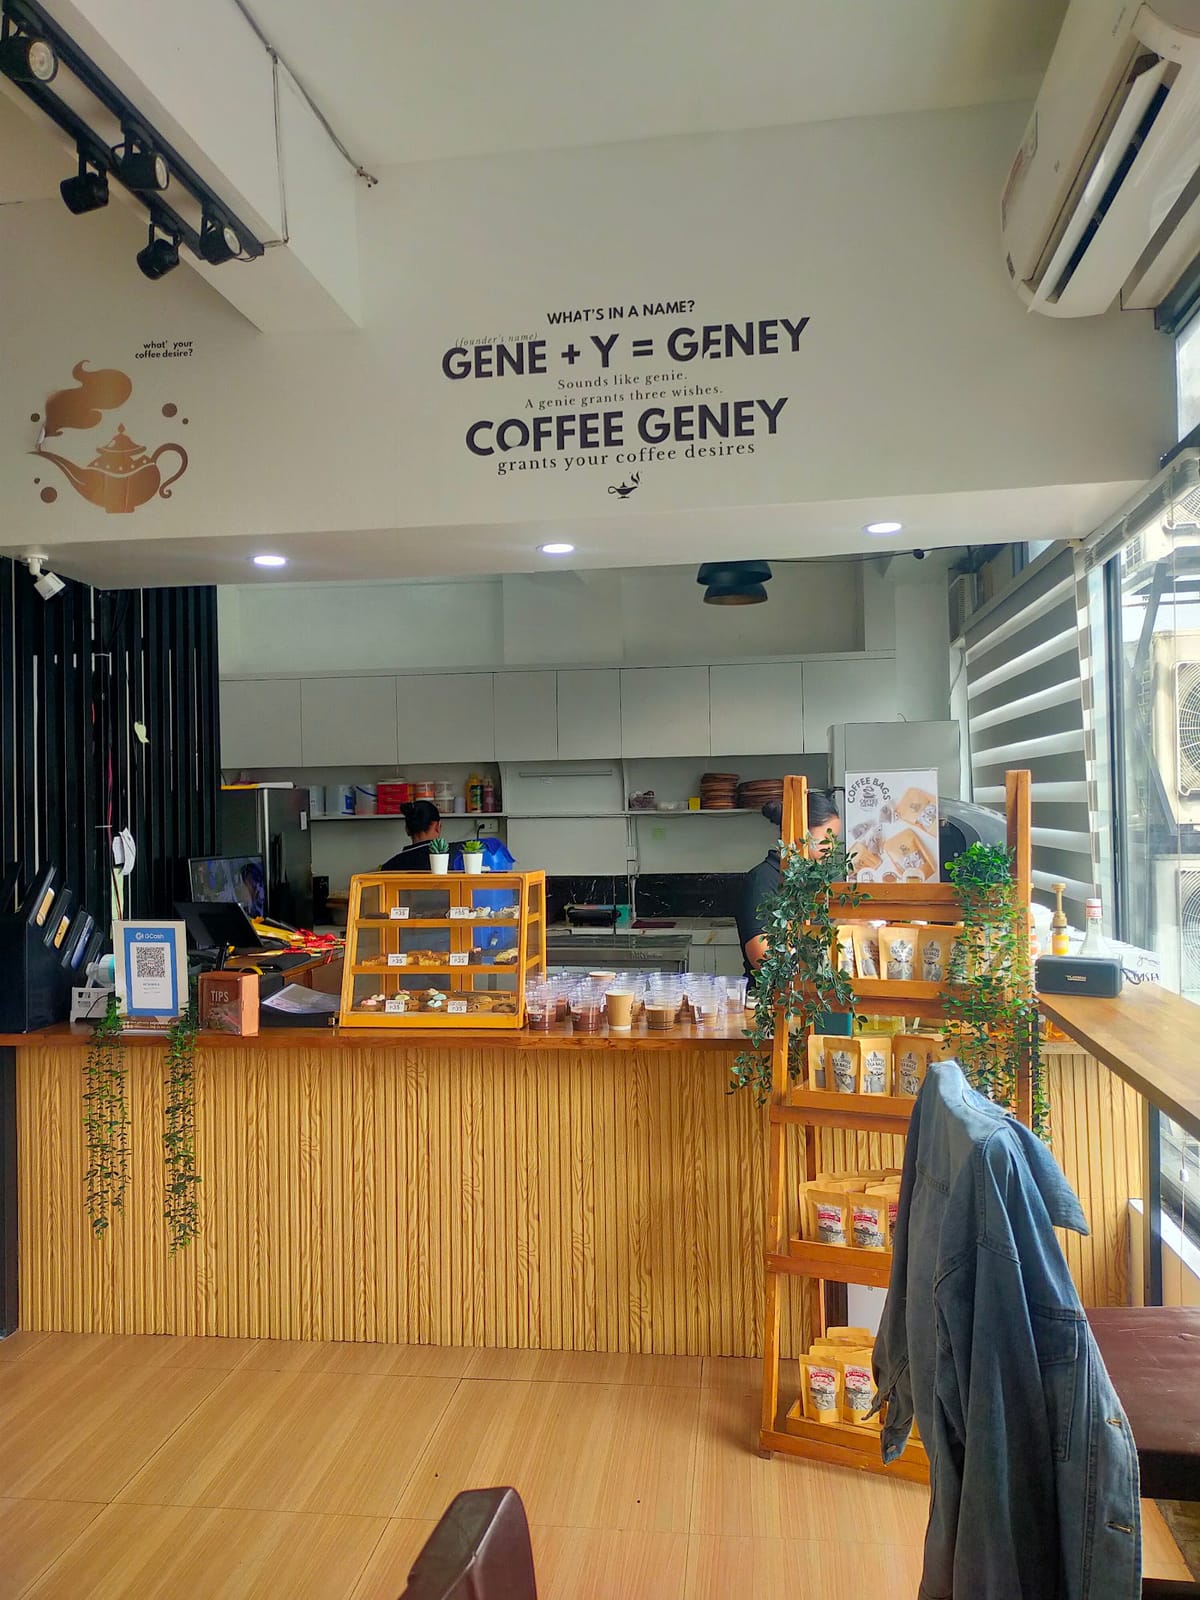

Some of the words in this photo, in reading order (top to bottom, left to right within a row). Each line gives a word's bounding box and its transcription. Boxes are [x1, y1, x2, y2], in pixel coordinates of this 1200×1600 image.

[547, 307, 604, 325] WHAT'S
[608, 305, 624, 320] IN
[628, 305, 639, 318] A
[643, 300, 695, 317] NAME?
[135, 350, 161, 359] coffee
[162, 349, 193, 358] desire?
[173, 340, 193, 350] your
[441, 340, 547, 380] GENE
[590, 333, 619, 368] Y
[667, 317, 810, 362] GENEY
[557, 375, 609, 391] Sounds
[613, 372, 640, 386] like
[645, 371, 688, 387] genie.
[524, 398, 534, 410] A
[538, 395, 576, 411] genie
[580, 392, 625, 407] grants
[629, 388, 666, 402] three
[672, 385, 723, 398] wishes.
[466, 410, 624, 456] COFFEE
[638, 397, 788, 444] GENEY
[497, 456, 557, 475] grants
[564, 452, 609, 471] your
[616, 446, 677, 464] coffee
[684, 440, 756, 460] desires
[848, 776, 872, 804] COFFEE
[872, 778, 891, 800] BAGS
[210, 990, 230, 1002] TIPS
